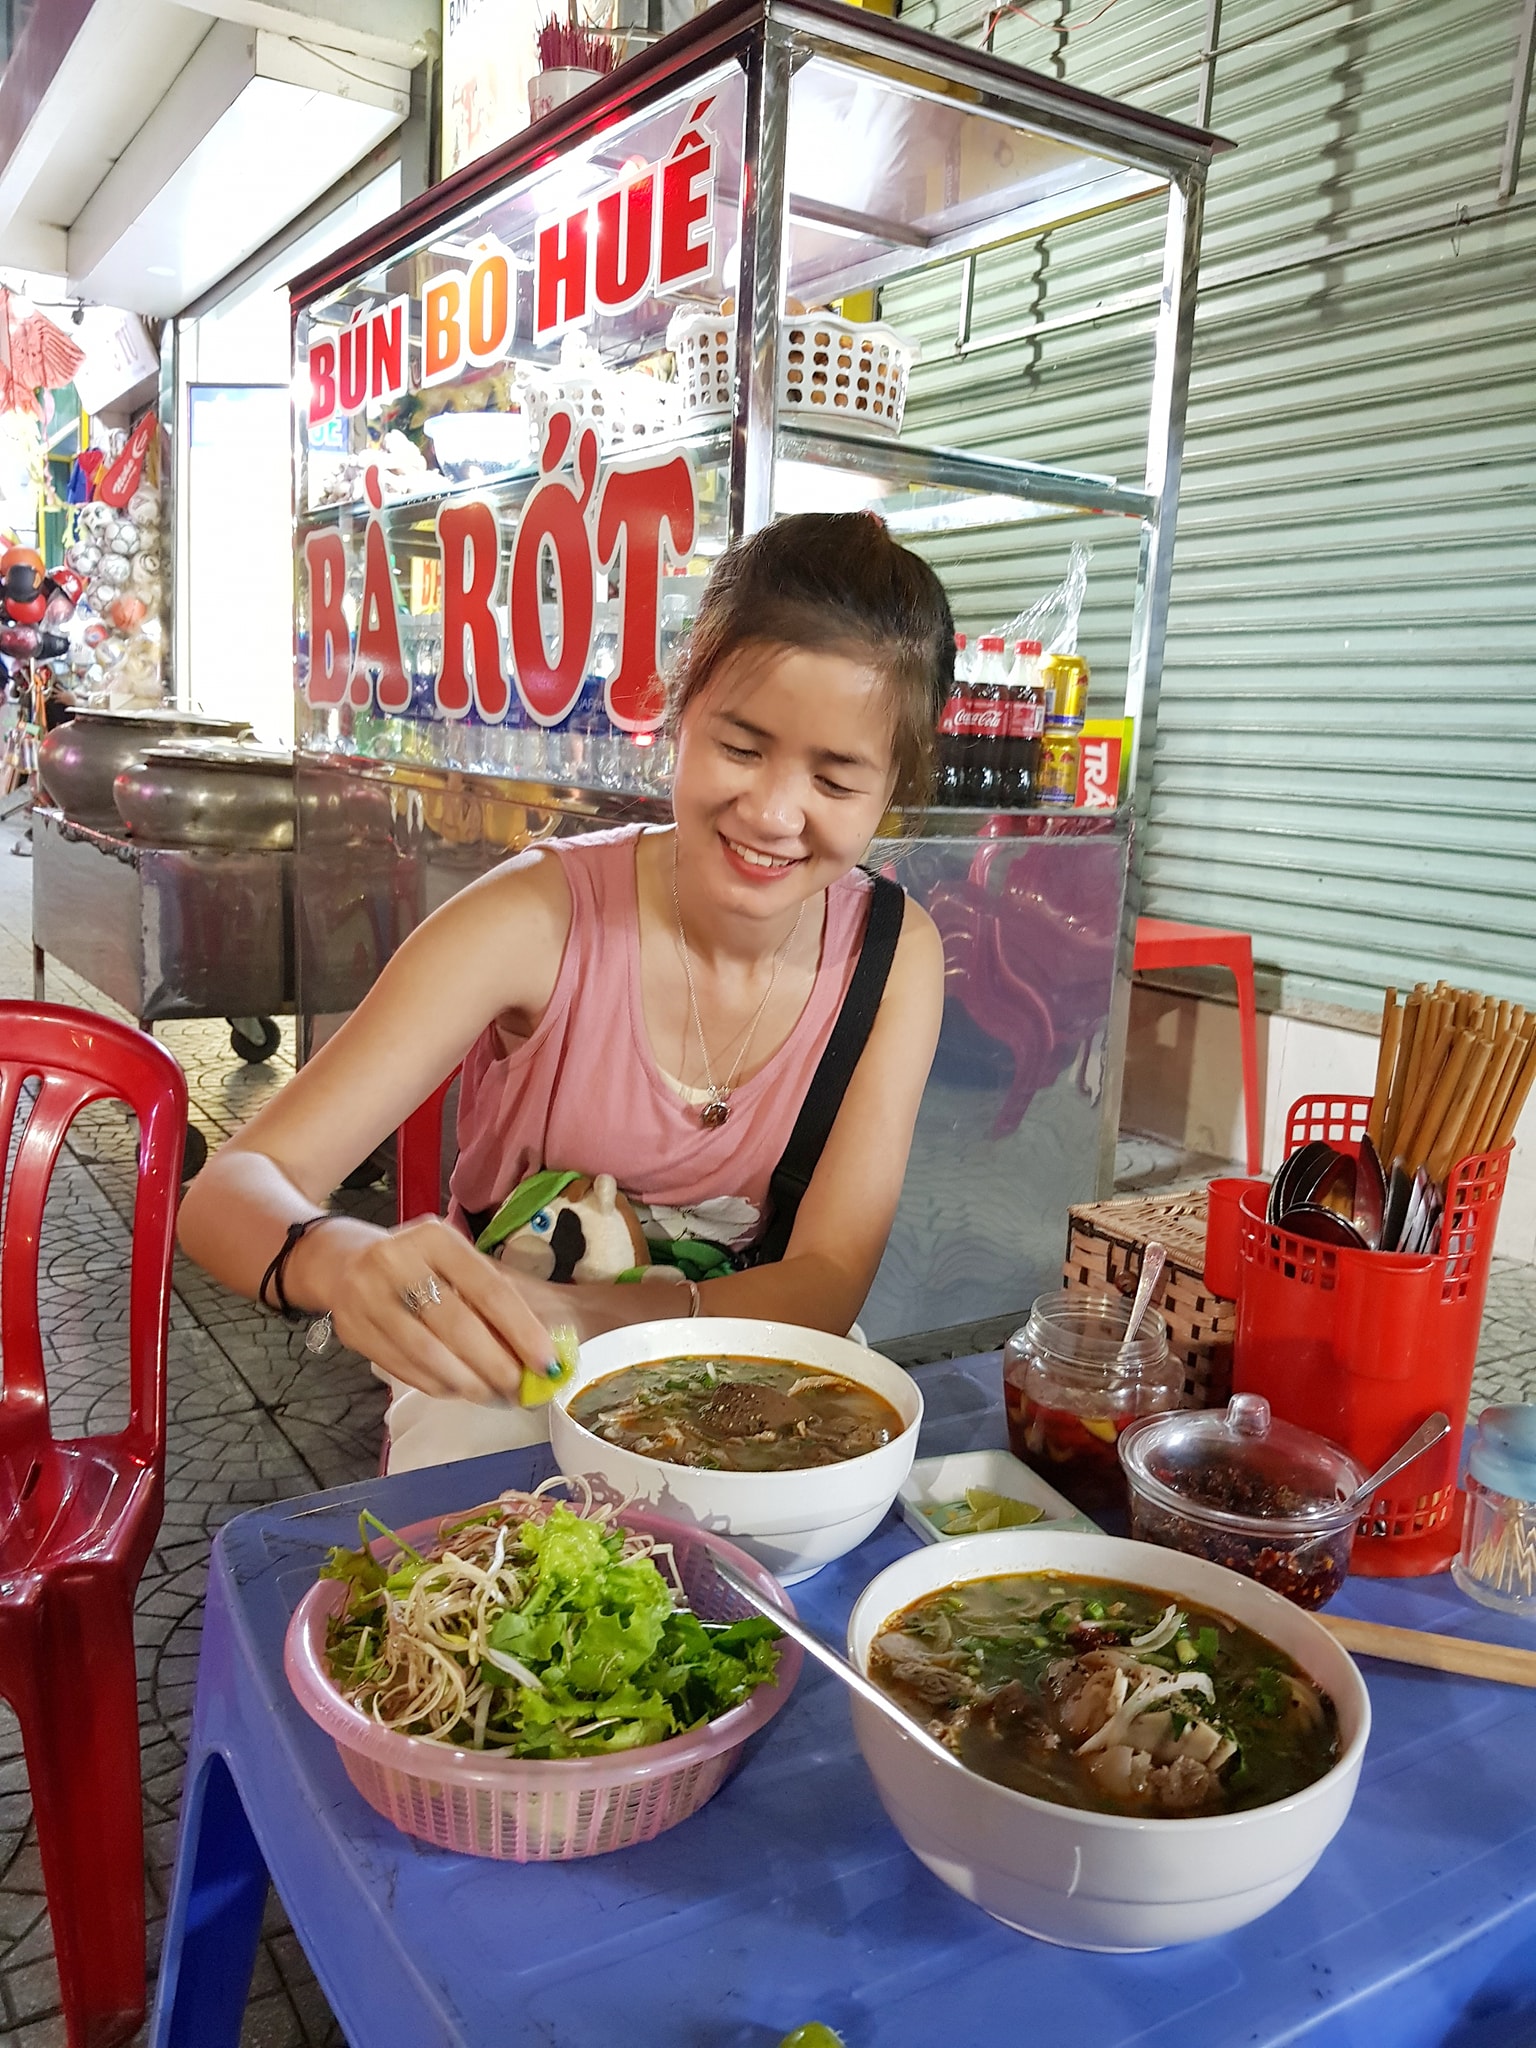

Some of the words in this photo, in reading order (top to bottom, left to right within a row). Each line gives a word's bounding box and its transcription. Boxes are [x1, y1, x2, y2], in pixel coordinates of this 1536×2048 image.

[308, 305, 403, 425] BÚN
[426, 243, 508, 378] BÒ
[537, 95, 716, 333] HUẾ
[307, 465, 410, 706] BÀ
[438, 412, 695, 721] RỚT
